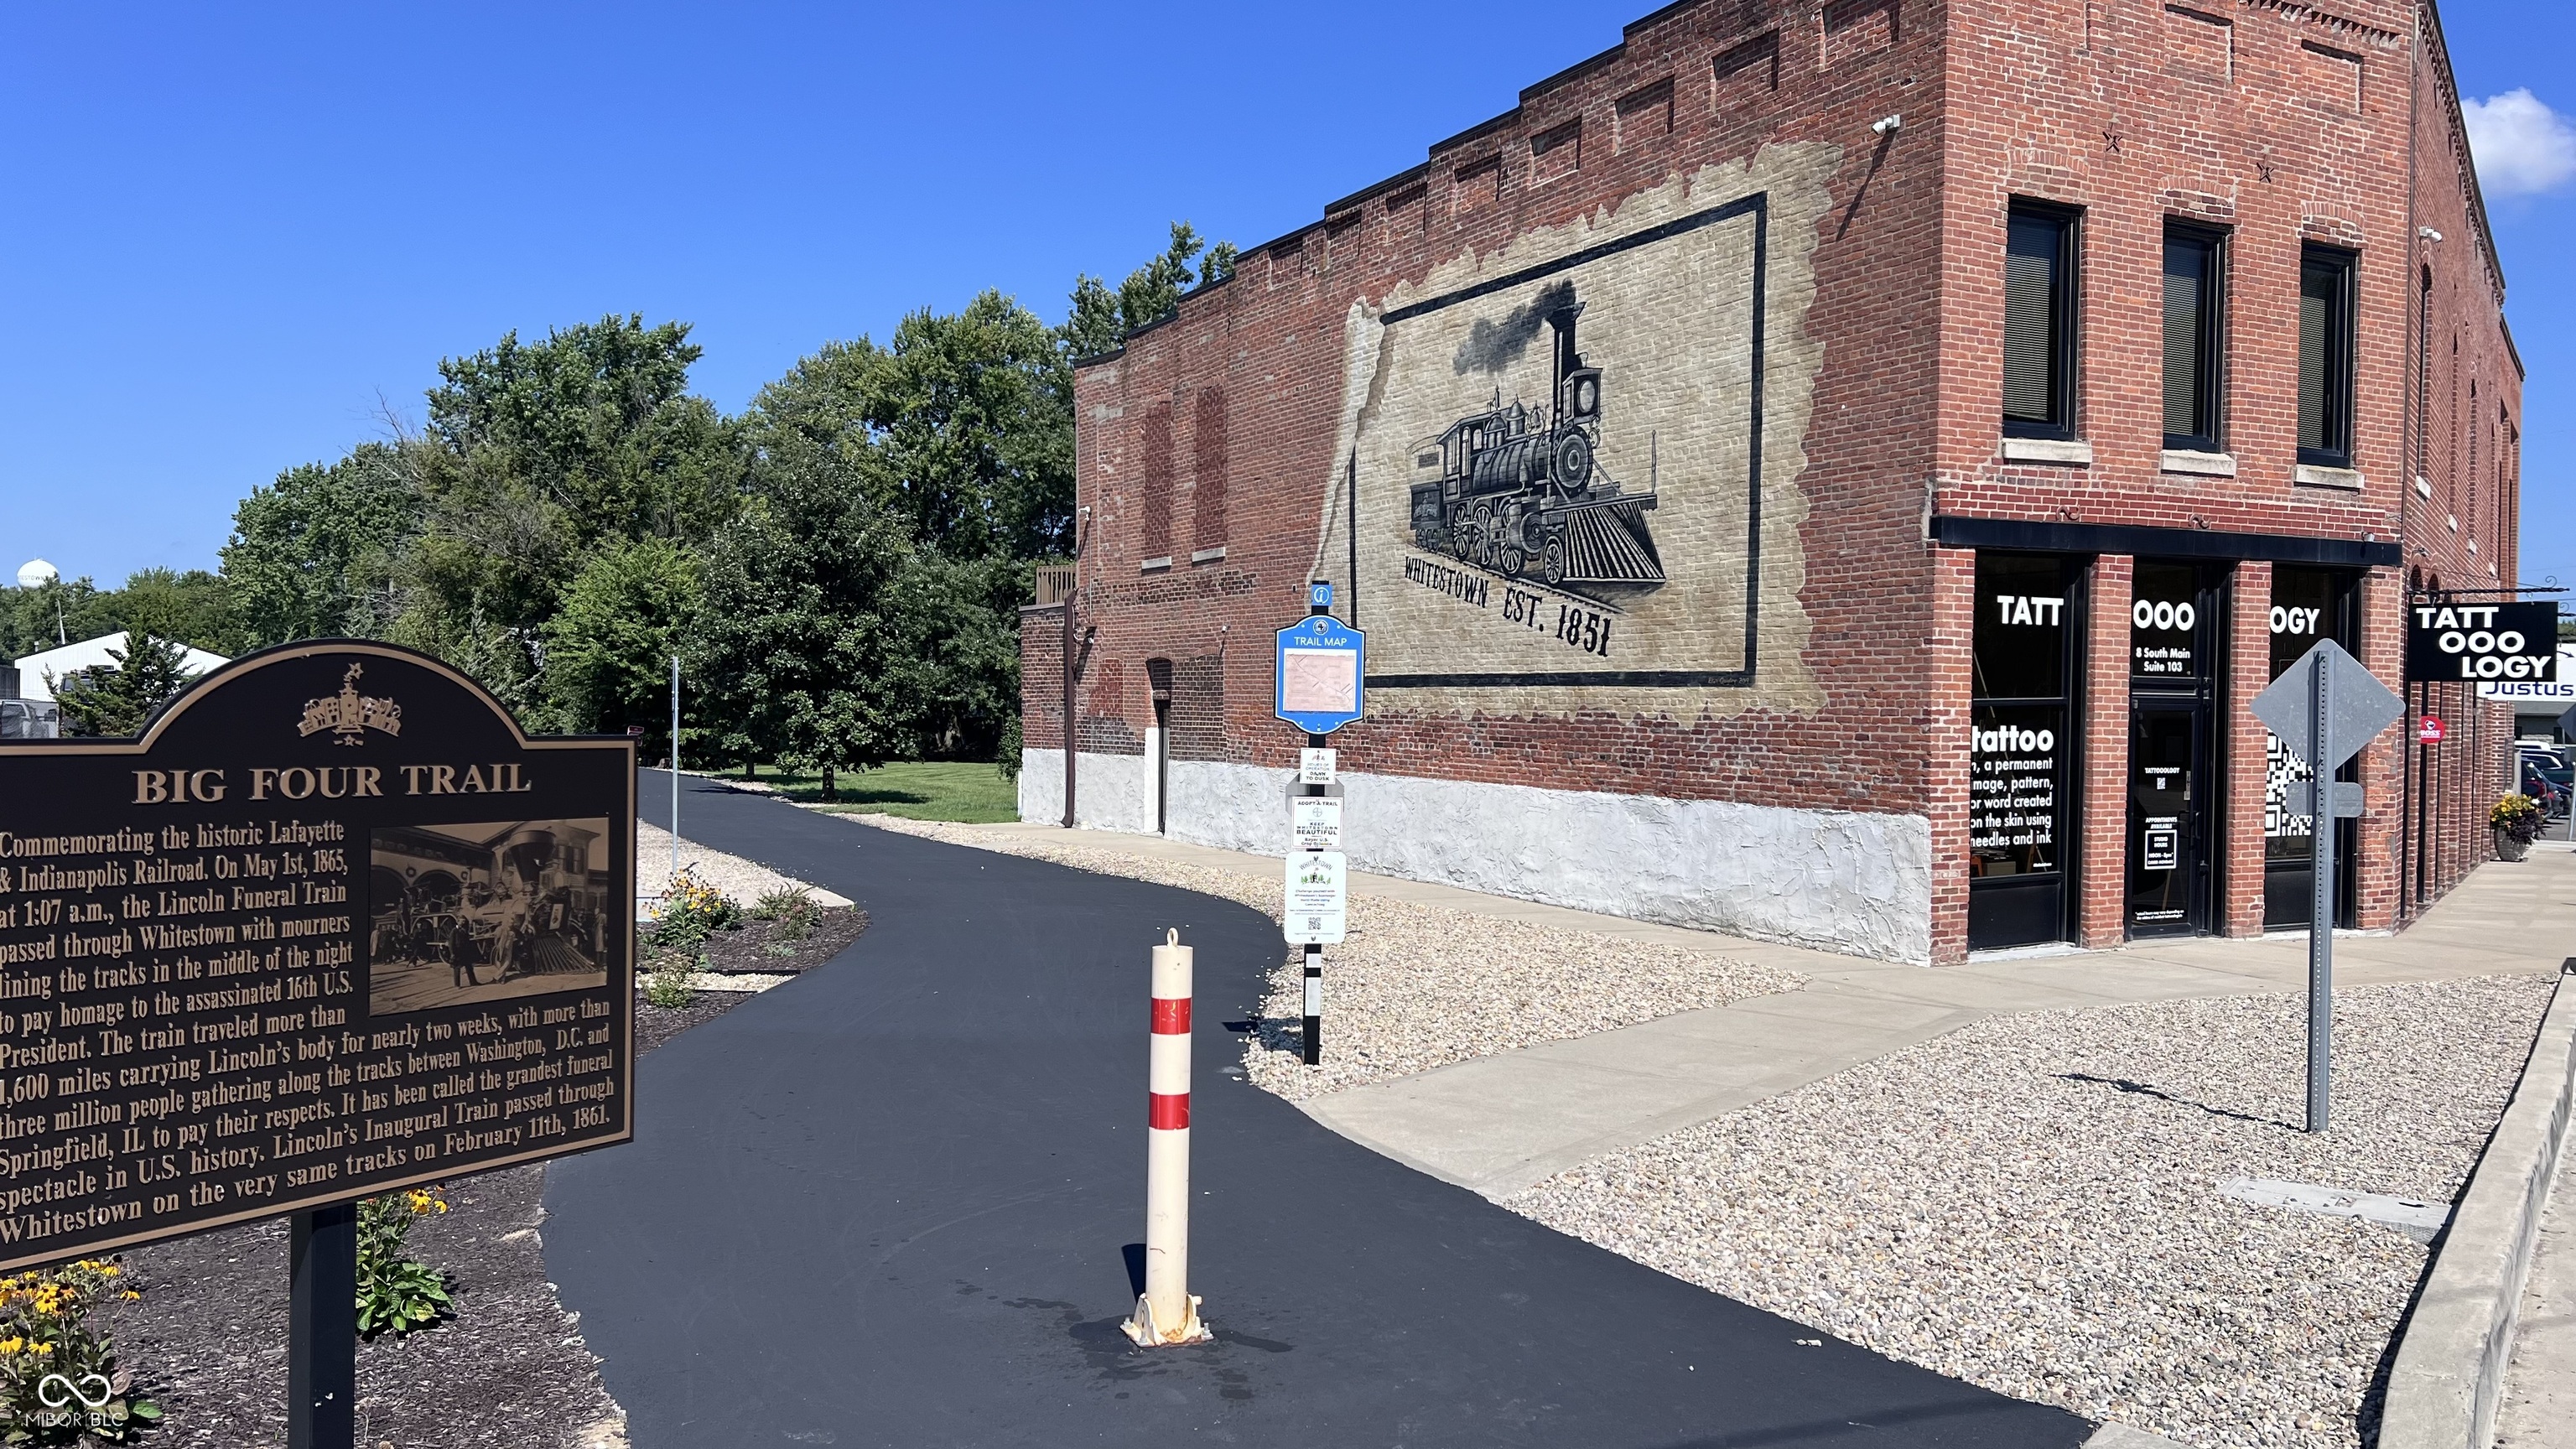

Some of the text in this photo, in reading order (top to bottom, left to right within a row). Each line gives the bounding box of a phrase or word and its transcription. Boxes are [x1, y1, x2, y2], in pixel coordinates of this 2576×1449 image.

[1405, 556, 1612, 657] WHITESTOWN EST. 1851
[1997, 595, 2320, 635] TATT OOO OGY
[2416, 606, 2499, 629] TATT
[1294, 636, 1348, 647] TRAIL MAP
[2136, 647, 2190, 659] 8 South Main
[2438, 631, 2525, 654] OOO
[2143, 661, 2183, 673] Suite 103
[2461, 655, 2552, 678] LOGY
[2485, 681, 2574, 696] Justus
[1971, 724, 2054, 752] tattoo
[132, 764, 531, 803] BIG FOUR TRAIL
[1984, 761, 1992, 771] a
[1995, 757, 2053, 775] permanent
[2011, 776, 2054, 793] pattern,
[1983, 792, 2011, 808] word
[2013, 792, 2053, 808] created
[1985, 812, 2002, 828] the
[2004, 811, 2023, 827] skin
[2026, 812, 2052, 828] using
[2012, 829, 2033, 845] and
[2036, 828, 2052, 844] ink
[0, 820, 344, 858] Commemorating the historic Lafayette
[0, 849, 347, 893] & Indianapolis Railroad. On May 1st, 1865,
[0, 880, 345, 928] at 1:07 a.m., the Lincoln Funeral Train
[0, 917, 350, 969] passed through Whitestown with mourners
[0, 941, 352, 1000] lining the tracks in the middle of the night
[0, 971, 352, 1037] to pay homage to the assassinated 16th U.S.
[0, 1005, 345, 1069] President. The train traveled more than
[0, 999, 609, 1109] 1,600 miles carrying Lincoln's body for nearly two weeks, with more than
[0, 1023, 609, 1140] three million people gathering along the tracks between Washington, D.C. and
[0, 1049, 612, 1179] Springfield, IL to pay their respects. It has been called the grandest funeral
[0, 1077, 614, 1214] spectacle in U.S. history. Lincoln's Inaugural Train passed through
[0, 1104, 610, 1244] Whitestown on the very same tracks on February 11th, 1861.
